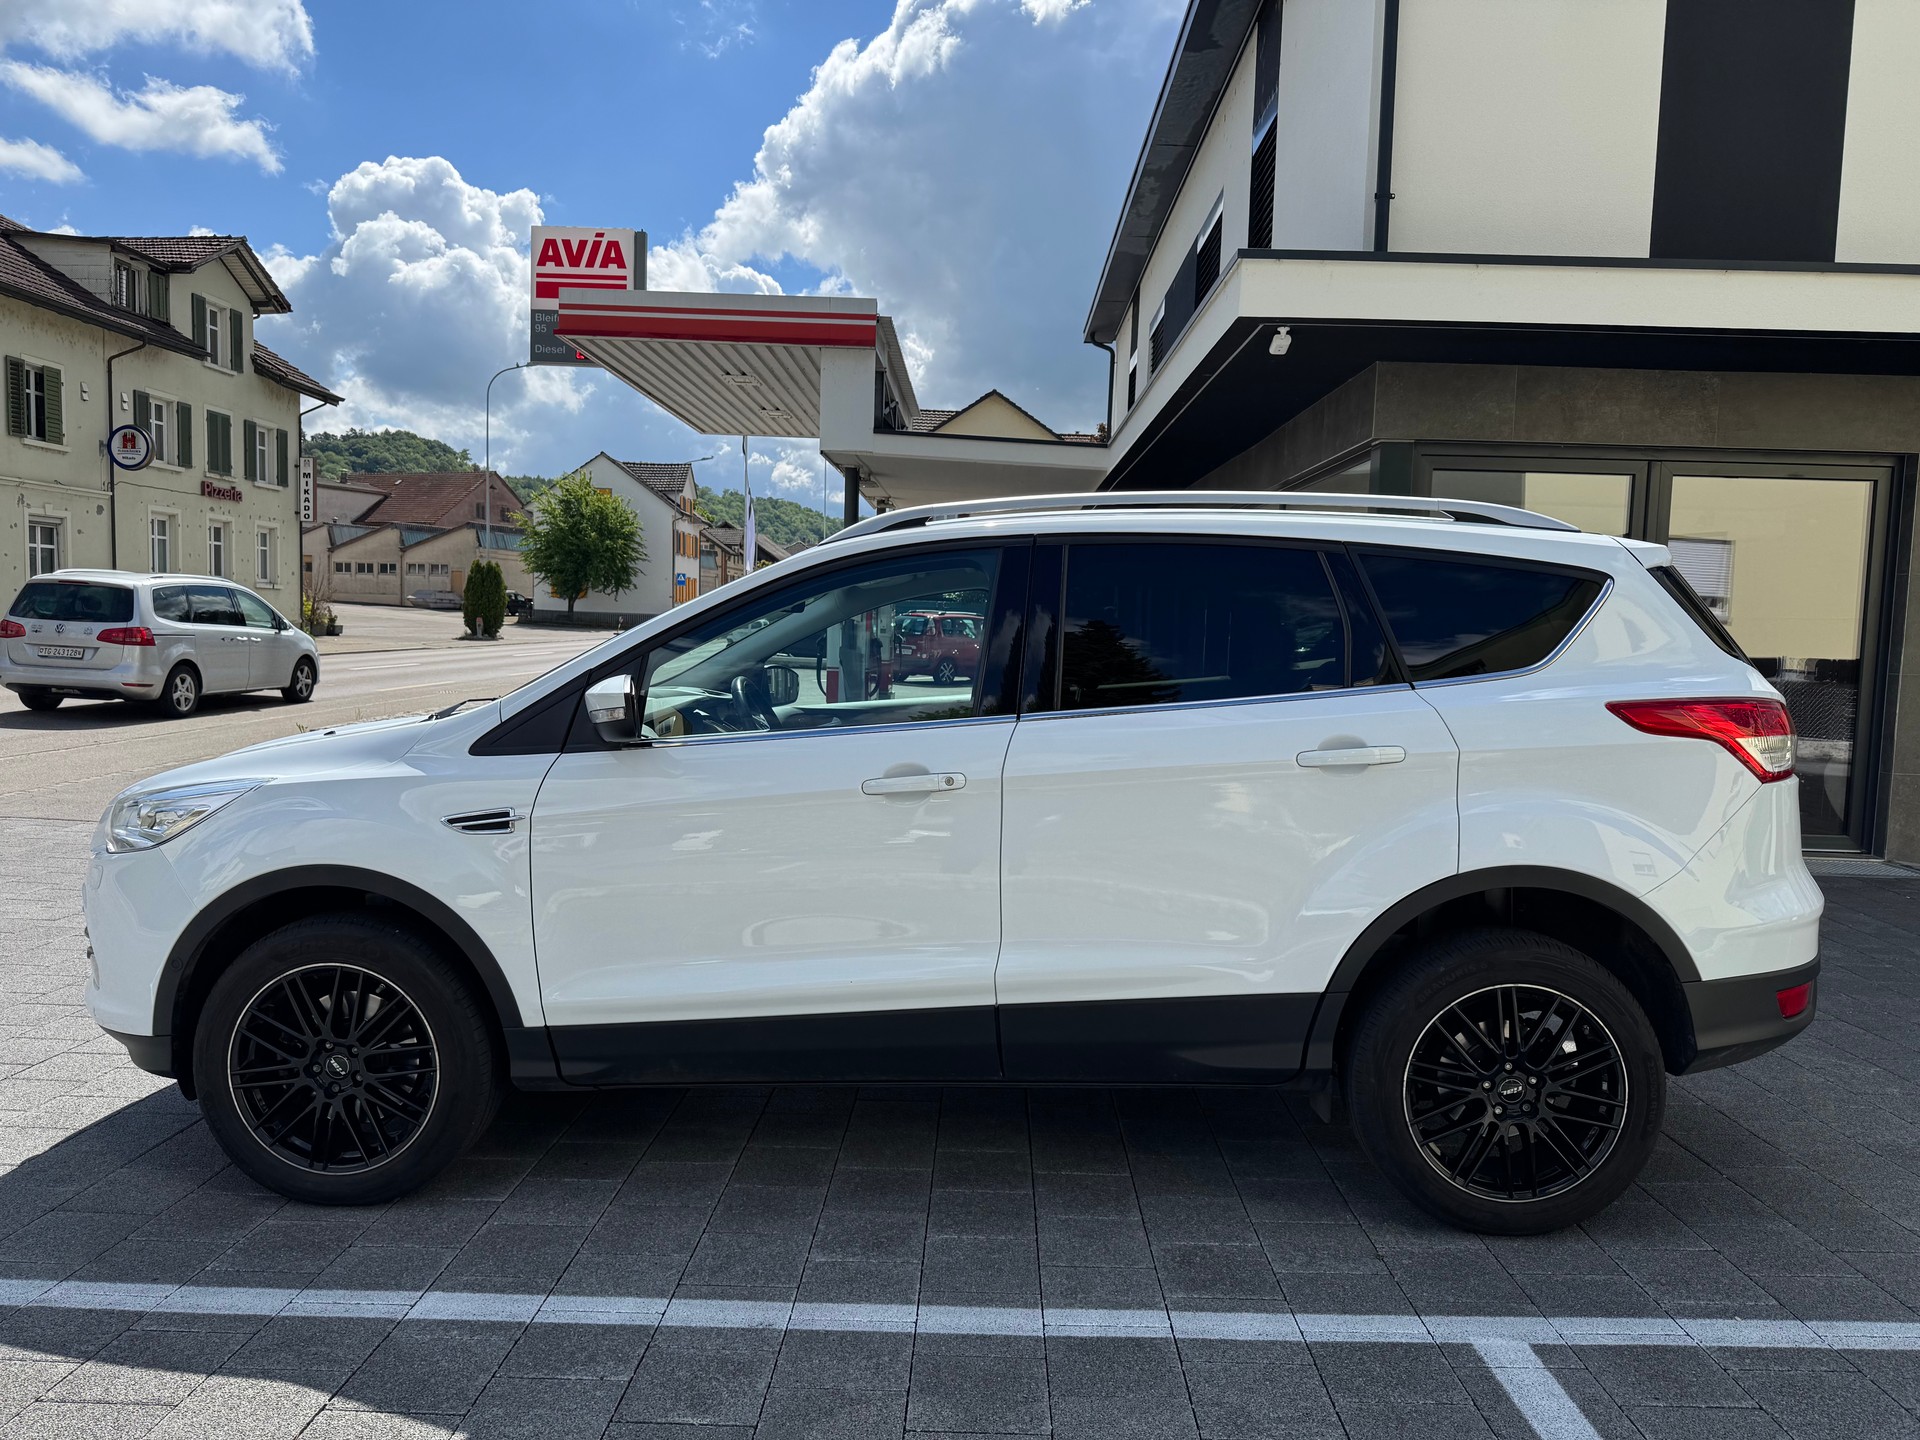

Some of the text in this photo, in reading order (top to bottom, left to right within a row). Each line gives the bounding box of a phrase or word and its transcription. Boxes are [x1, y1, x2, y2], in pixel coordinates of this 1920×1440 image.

[534, 323, 547, 333] 95
[534, 344, 566, 354] Diesel
[203, 480, 243, 503] Pizzeria
[302, 472, 311, 520] MIKADO
